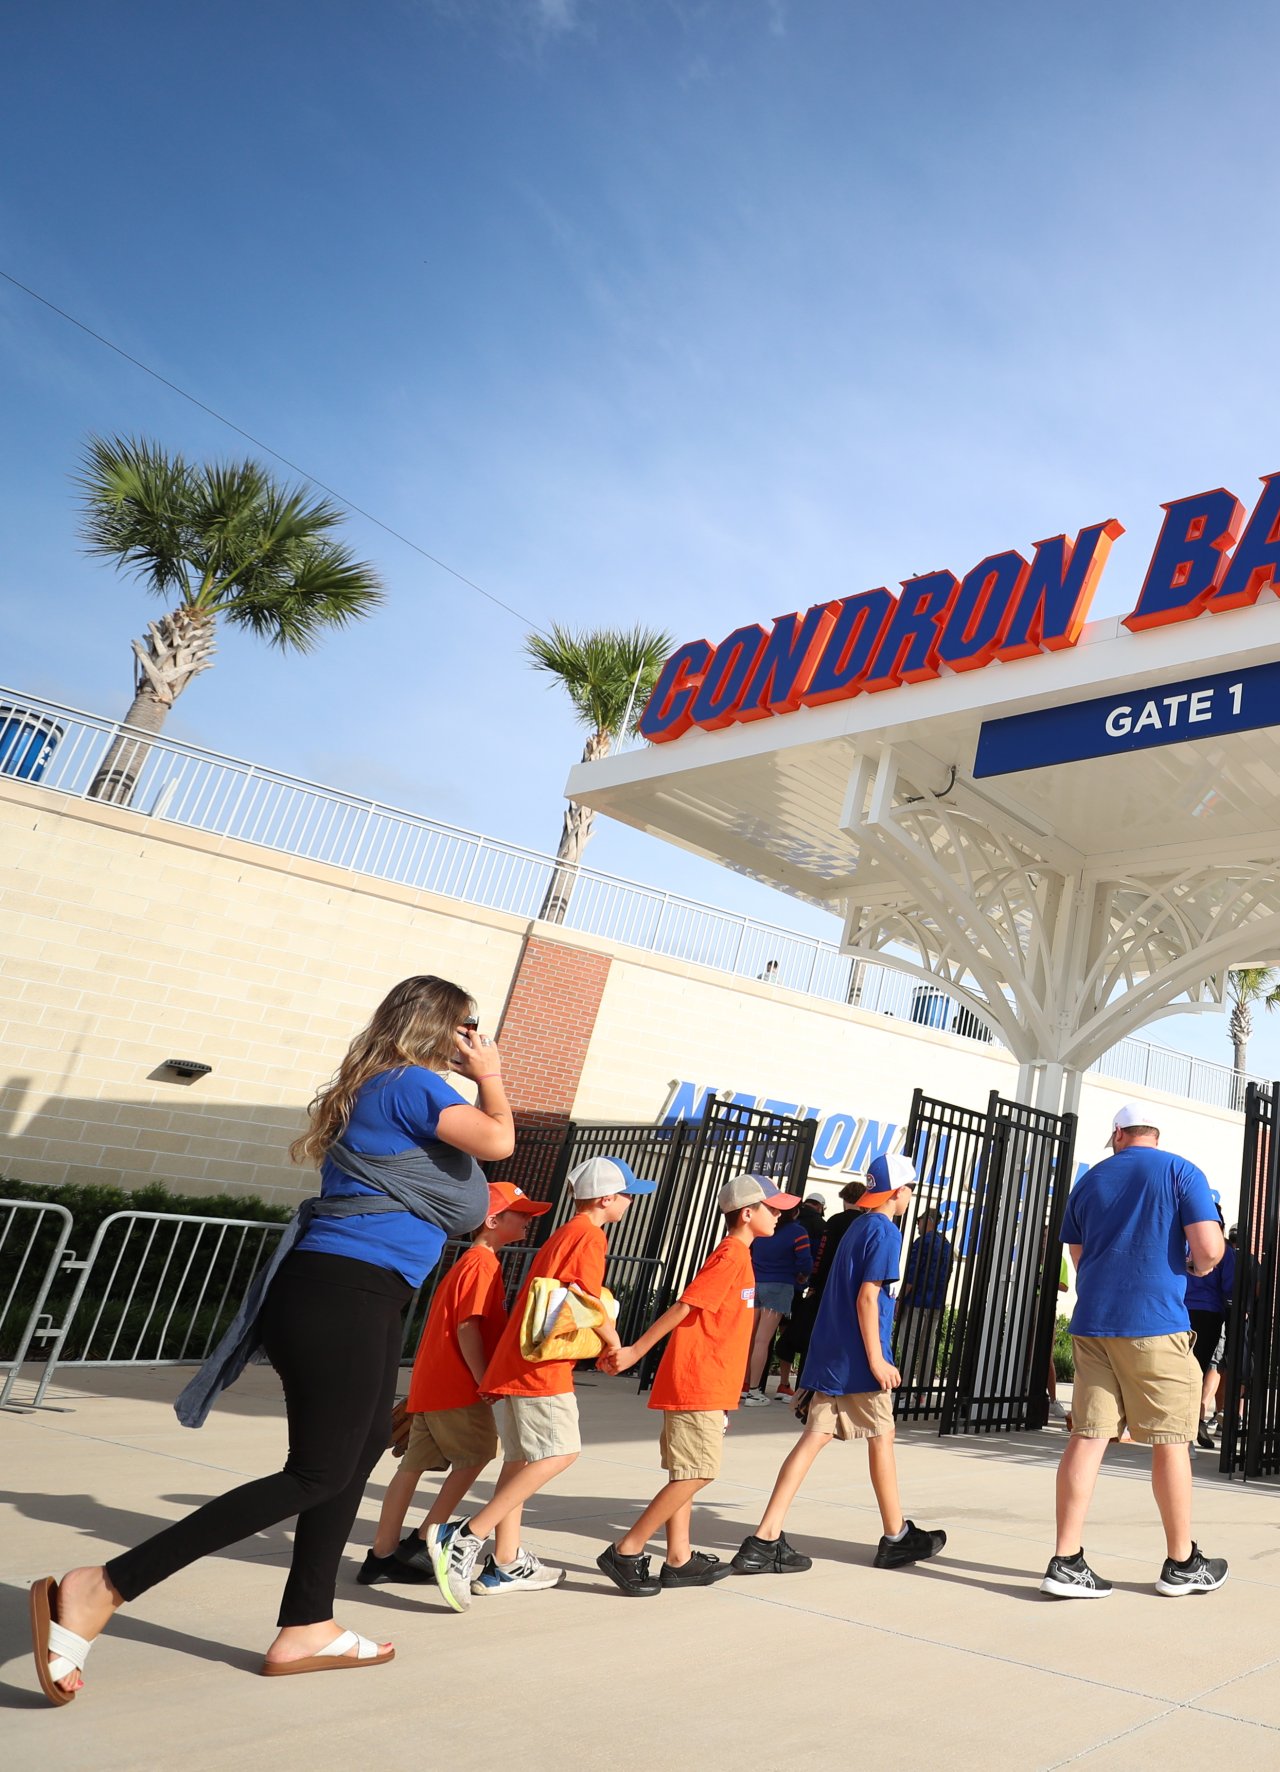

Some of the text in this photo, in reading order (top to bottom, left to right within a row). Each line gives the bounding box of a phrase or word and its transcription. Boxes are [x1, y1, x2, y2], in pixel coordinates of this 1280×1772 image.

[638, 518, 1126, 744] CONDRON
[1105, 682, 1244, 737] GATE 1
